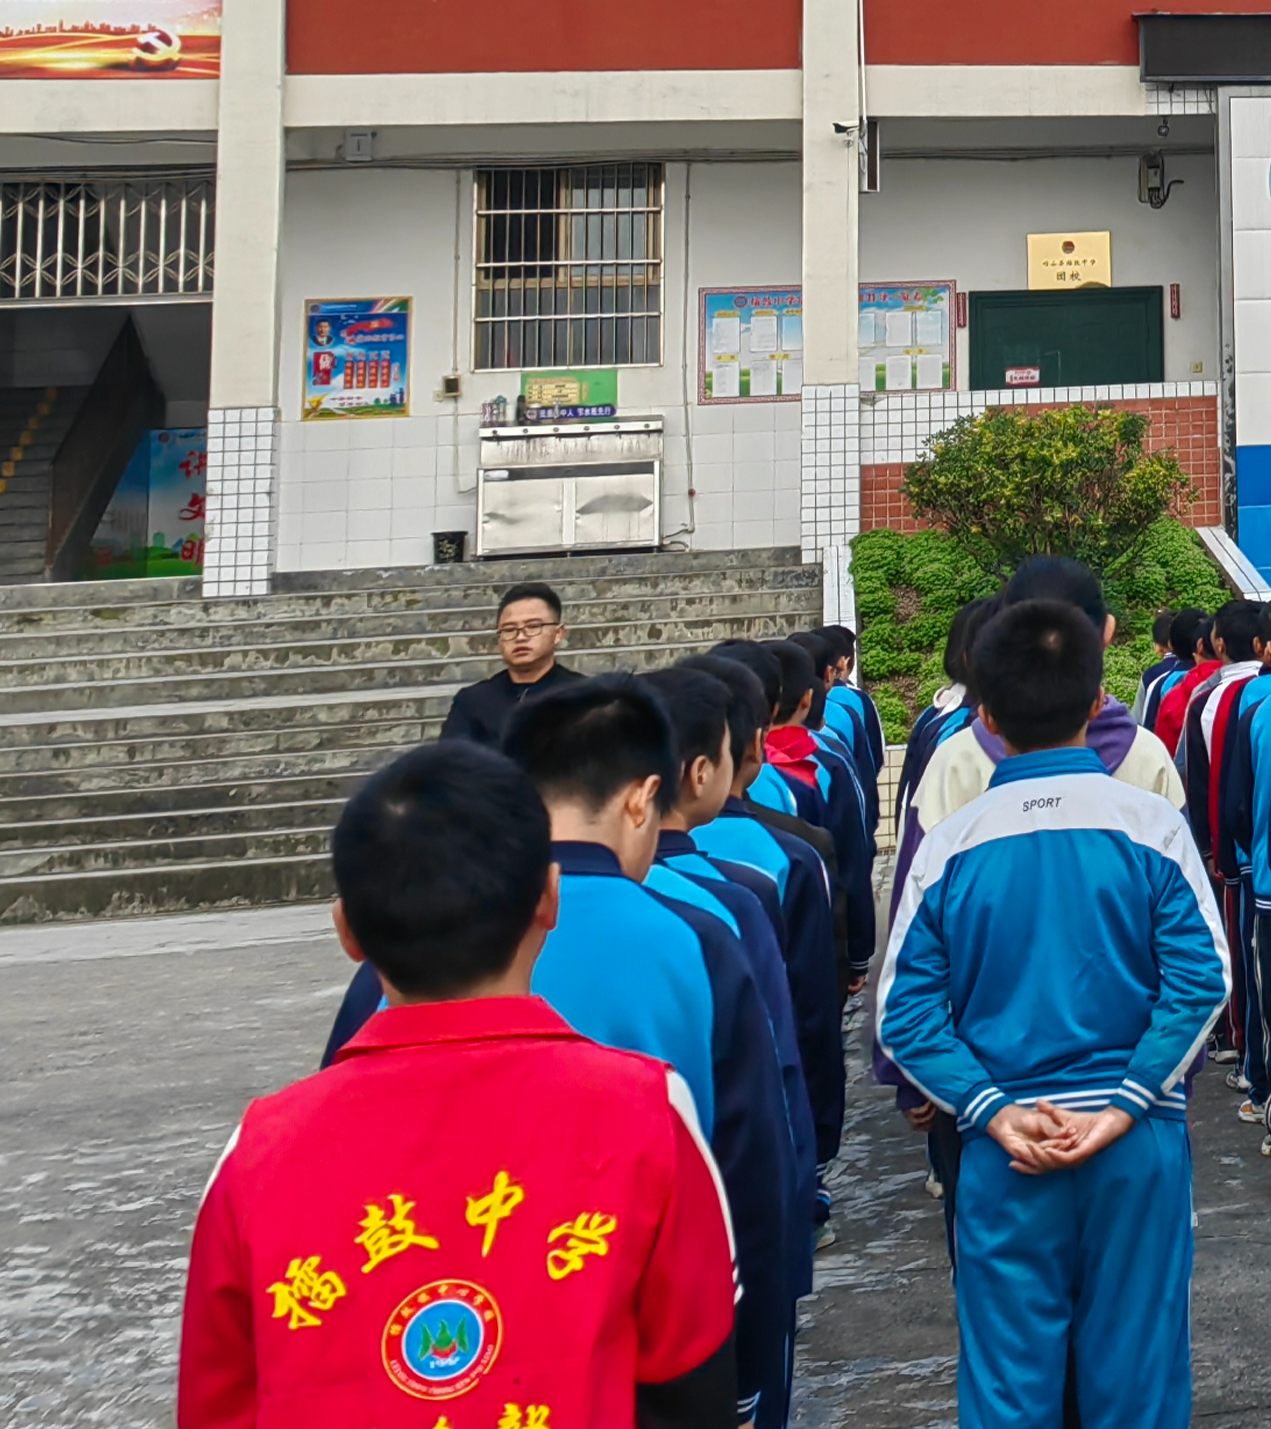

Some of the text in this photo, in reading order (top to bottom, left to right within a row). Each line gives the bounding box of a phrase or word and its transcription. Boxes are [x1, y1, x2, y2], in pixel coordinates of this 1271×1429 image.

[1056, 270, 1082, 282] 团校
[1022, 796, 1062, 812] SPORT
[266, 1170, 619, 1331] 擂鼓中学
